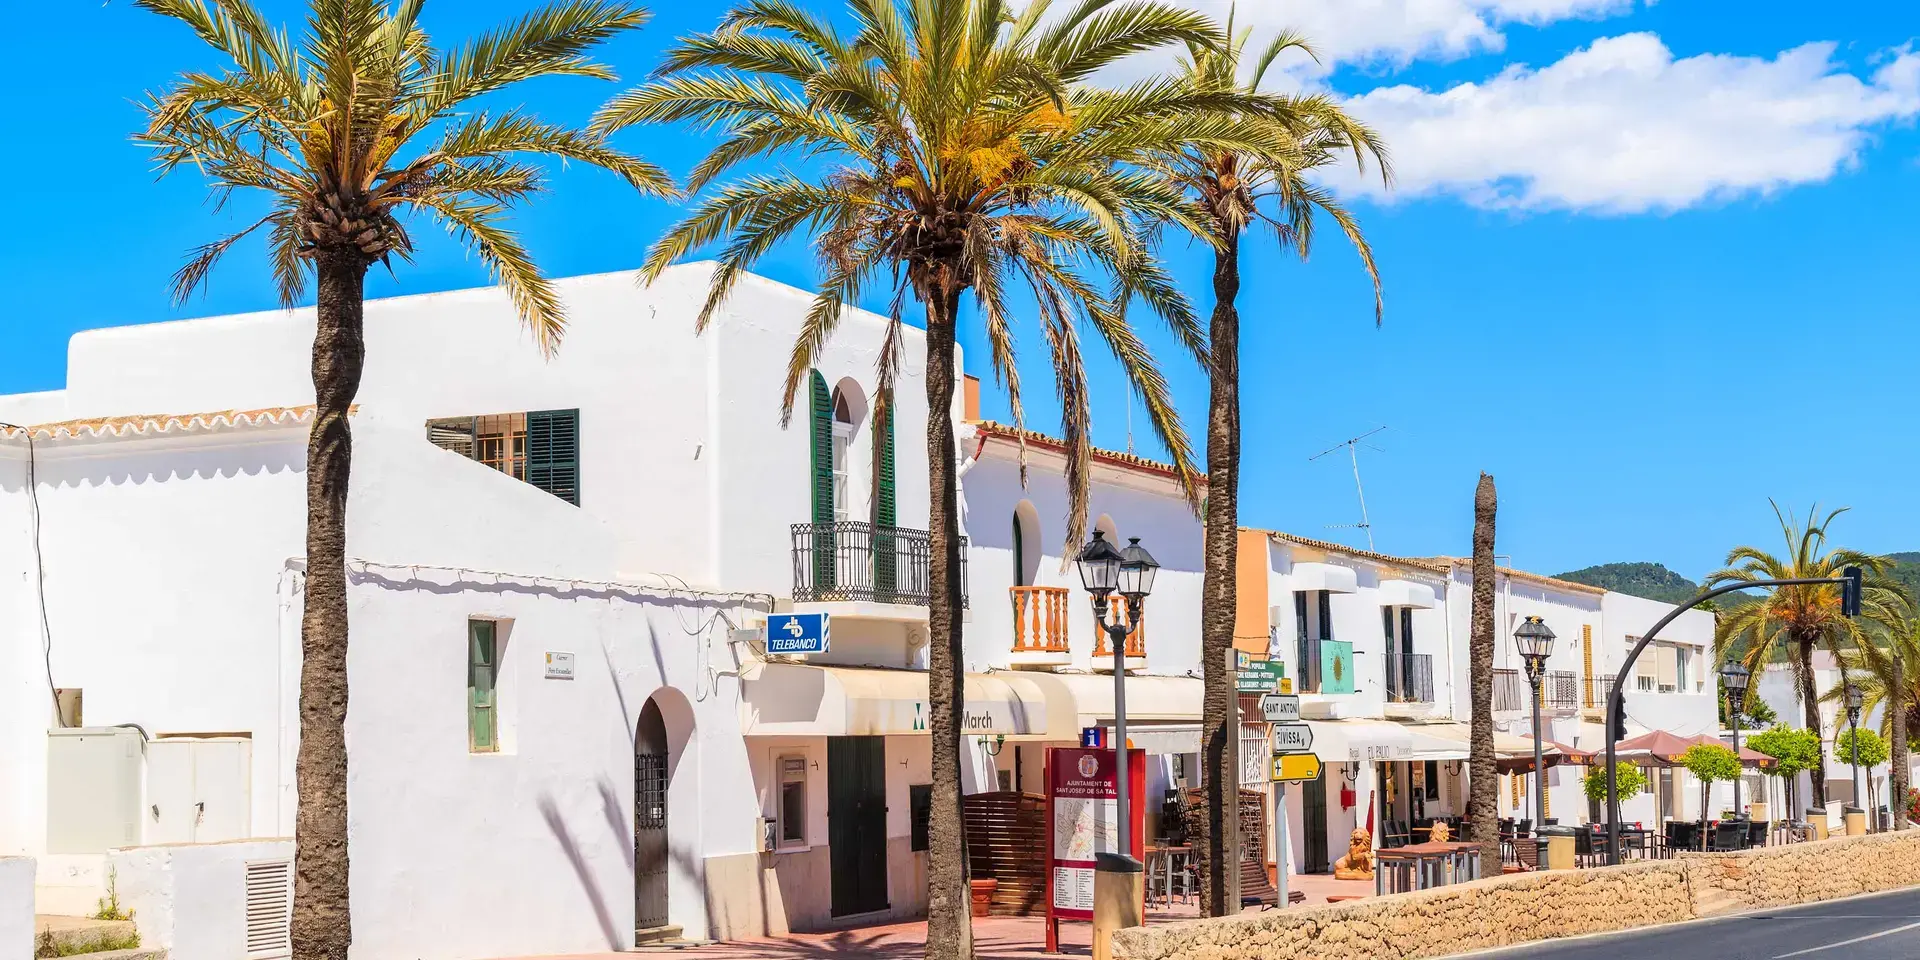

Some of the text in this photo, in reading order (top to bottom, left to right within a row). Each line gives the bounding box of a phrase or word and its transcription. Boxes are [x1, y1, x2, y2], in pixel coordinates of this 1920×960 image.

[772, 638, 817, 650] TELEBANCO
[1266, 703, 1298, 714] SANT ANTONI
[961, 711, 992, 729] March
